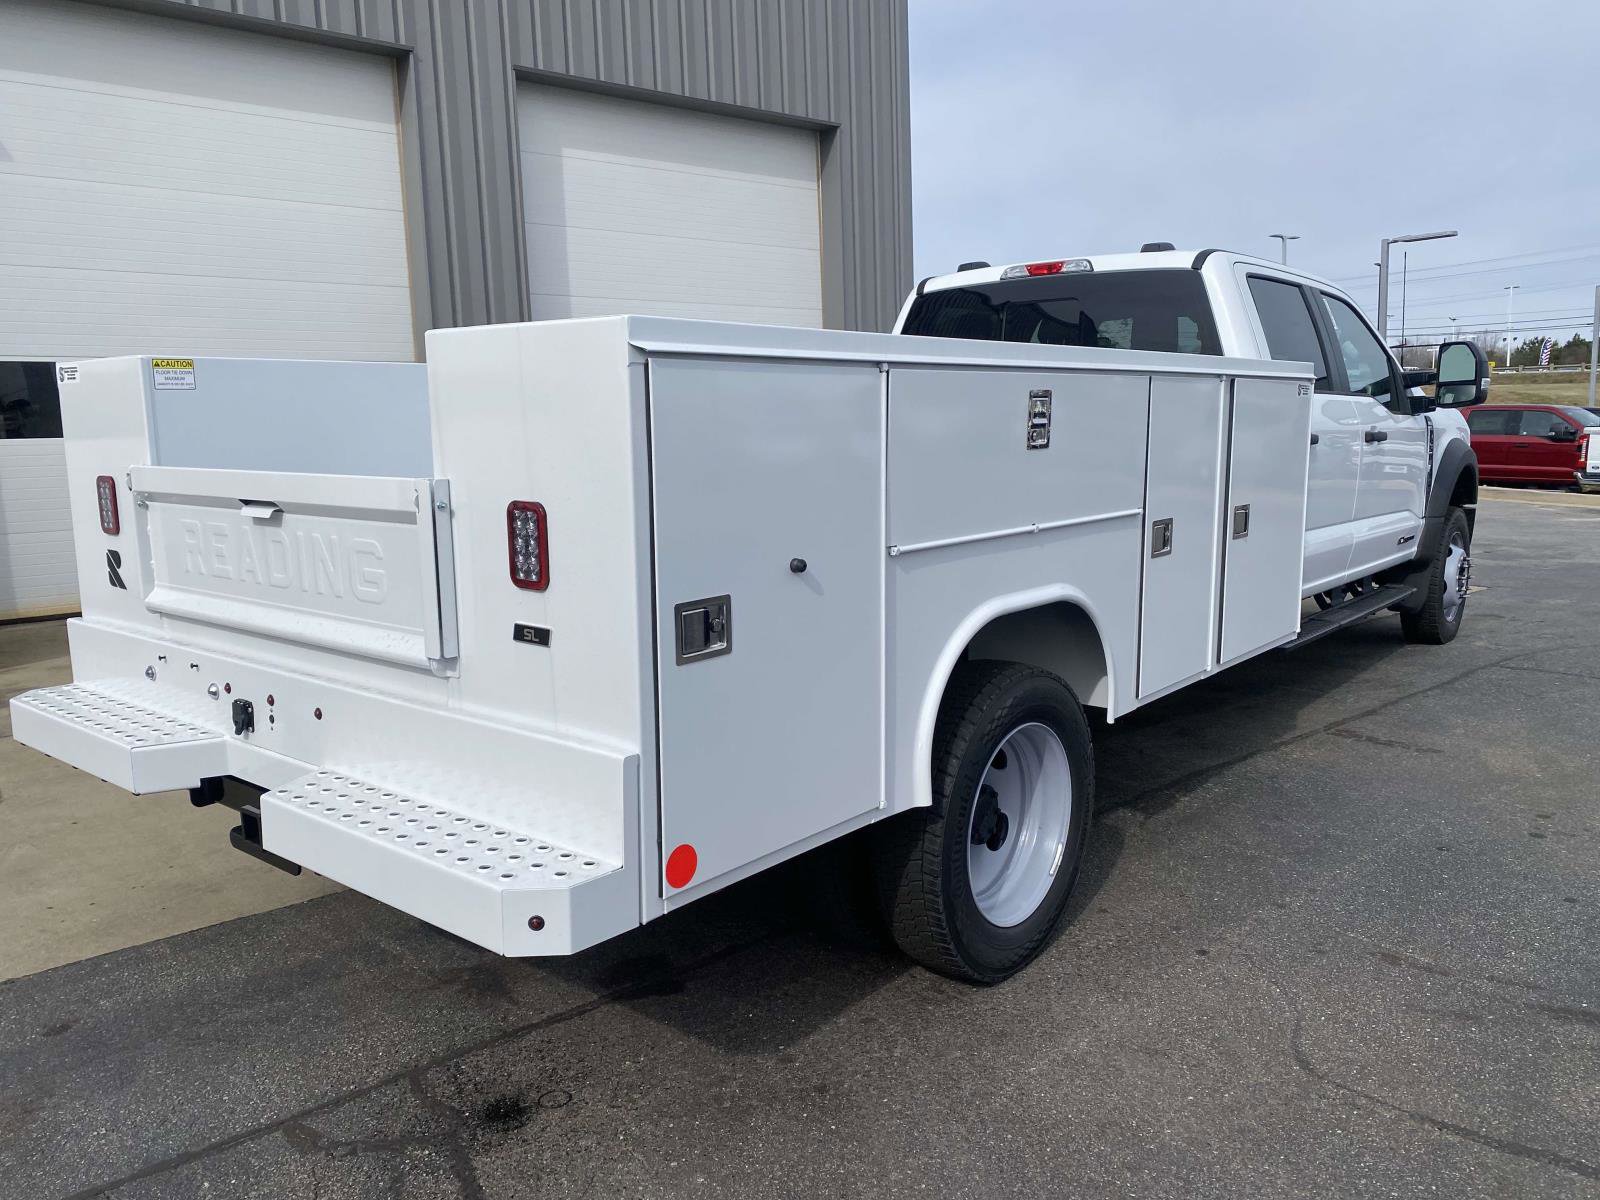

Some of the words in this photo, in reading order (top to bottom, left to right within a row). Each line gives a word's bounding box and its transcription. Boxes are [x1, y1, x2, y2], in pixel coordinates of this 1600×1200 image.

[160, 360, 192, 368] CAUTION
[179, 518, 387, 605] READING
[523, 628, 540, 642] SL
